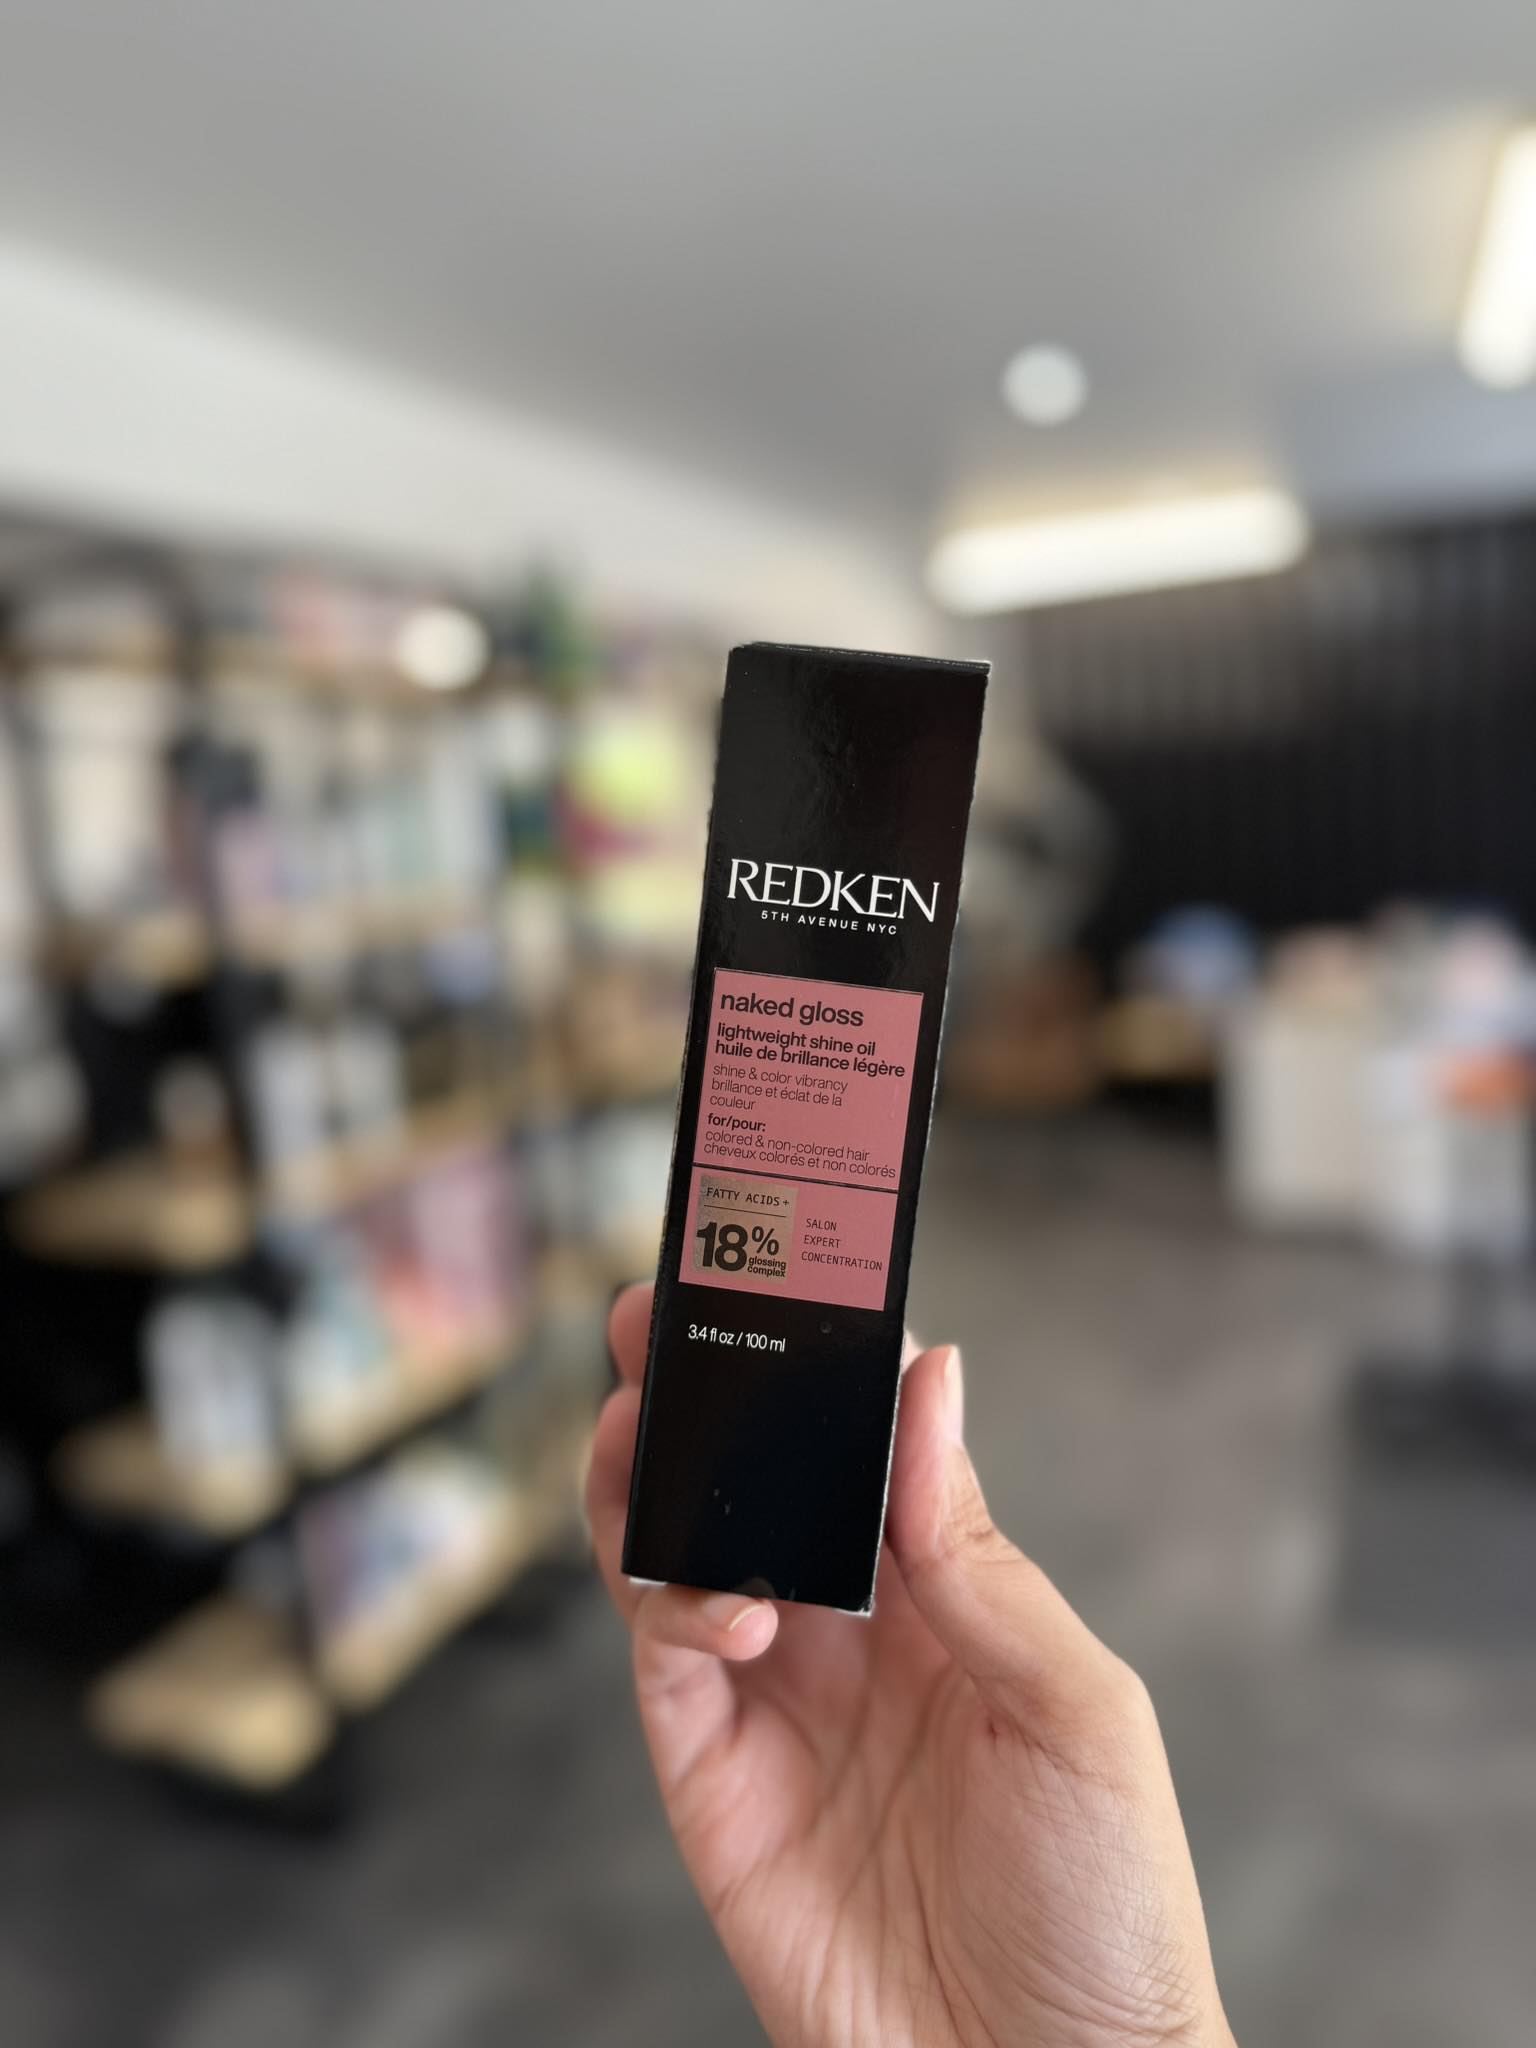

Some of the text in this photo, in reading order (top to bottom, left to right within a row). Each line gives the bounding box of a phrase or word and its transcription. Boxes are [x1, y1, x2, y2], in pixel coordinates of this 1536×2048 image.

[727, 859, 940, 922] REDKEN
[761, 911, 897, 934] 5TH AVENUE NYC
[721, 993, 864, 1026] naked gloss
[718, 1023, 875, 1056] lightweight shine oil
[715, 1040, 905, 1077] huile de brillance légère
[713, 1064, 848, 1093] shine & color vibrancy
[710, 1095, 756, 1110] couleur
[712, 1078, 842, 1106] brillance et éclat de la
[708, 1113, 766, 1132] for/pour:
[706, 1130, 870, 1161] colored & non-colored hair
[704, 1144, 896, 1178] cheveux colorés et non colorés
[706, 1188, 740, 1200] FATTY
[806, 1219, 837, 1231] SALON
[804, 1235, 841, 1248] EXPERT
[747, 1265, 786, 1277] complex
[749, 1256, 787, 1270] glossing
[801, 1252, 882, 1271] CONCENTRATION
[688, 1324, 707, 1340] 3.4
[710, 1327, 717, 1341] fl
[719, 1331, 734, 1344] oz
[746, 1334, 767, 1349] 100
[771, 1338, 785, 1352] ml
